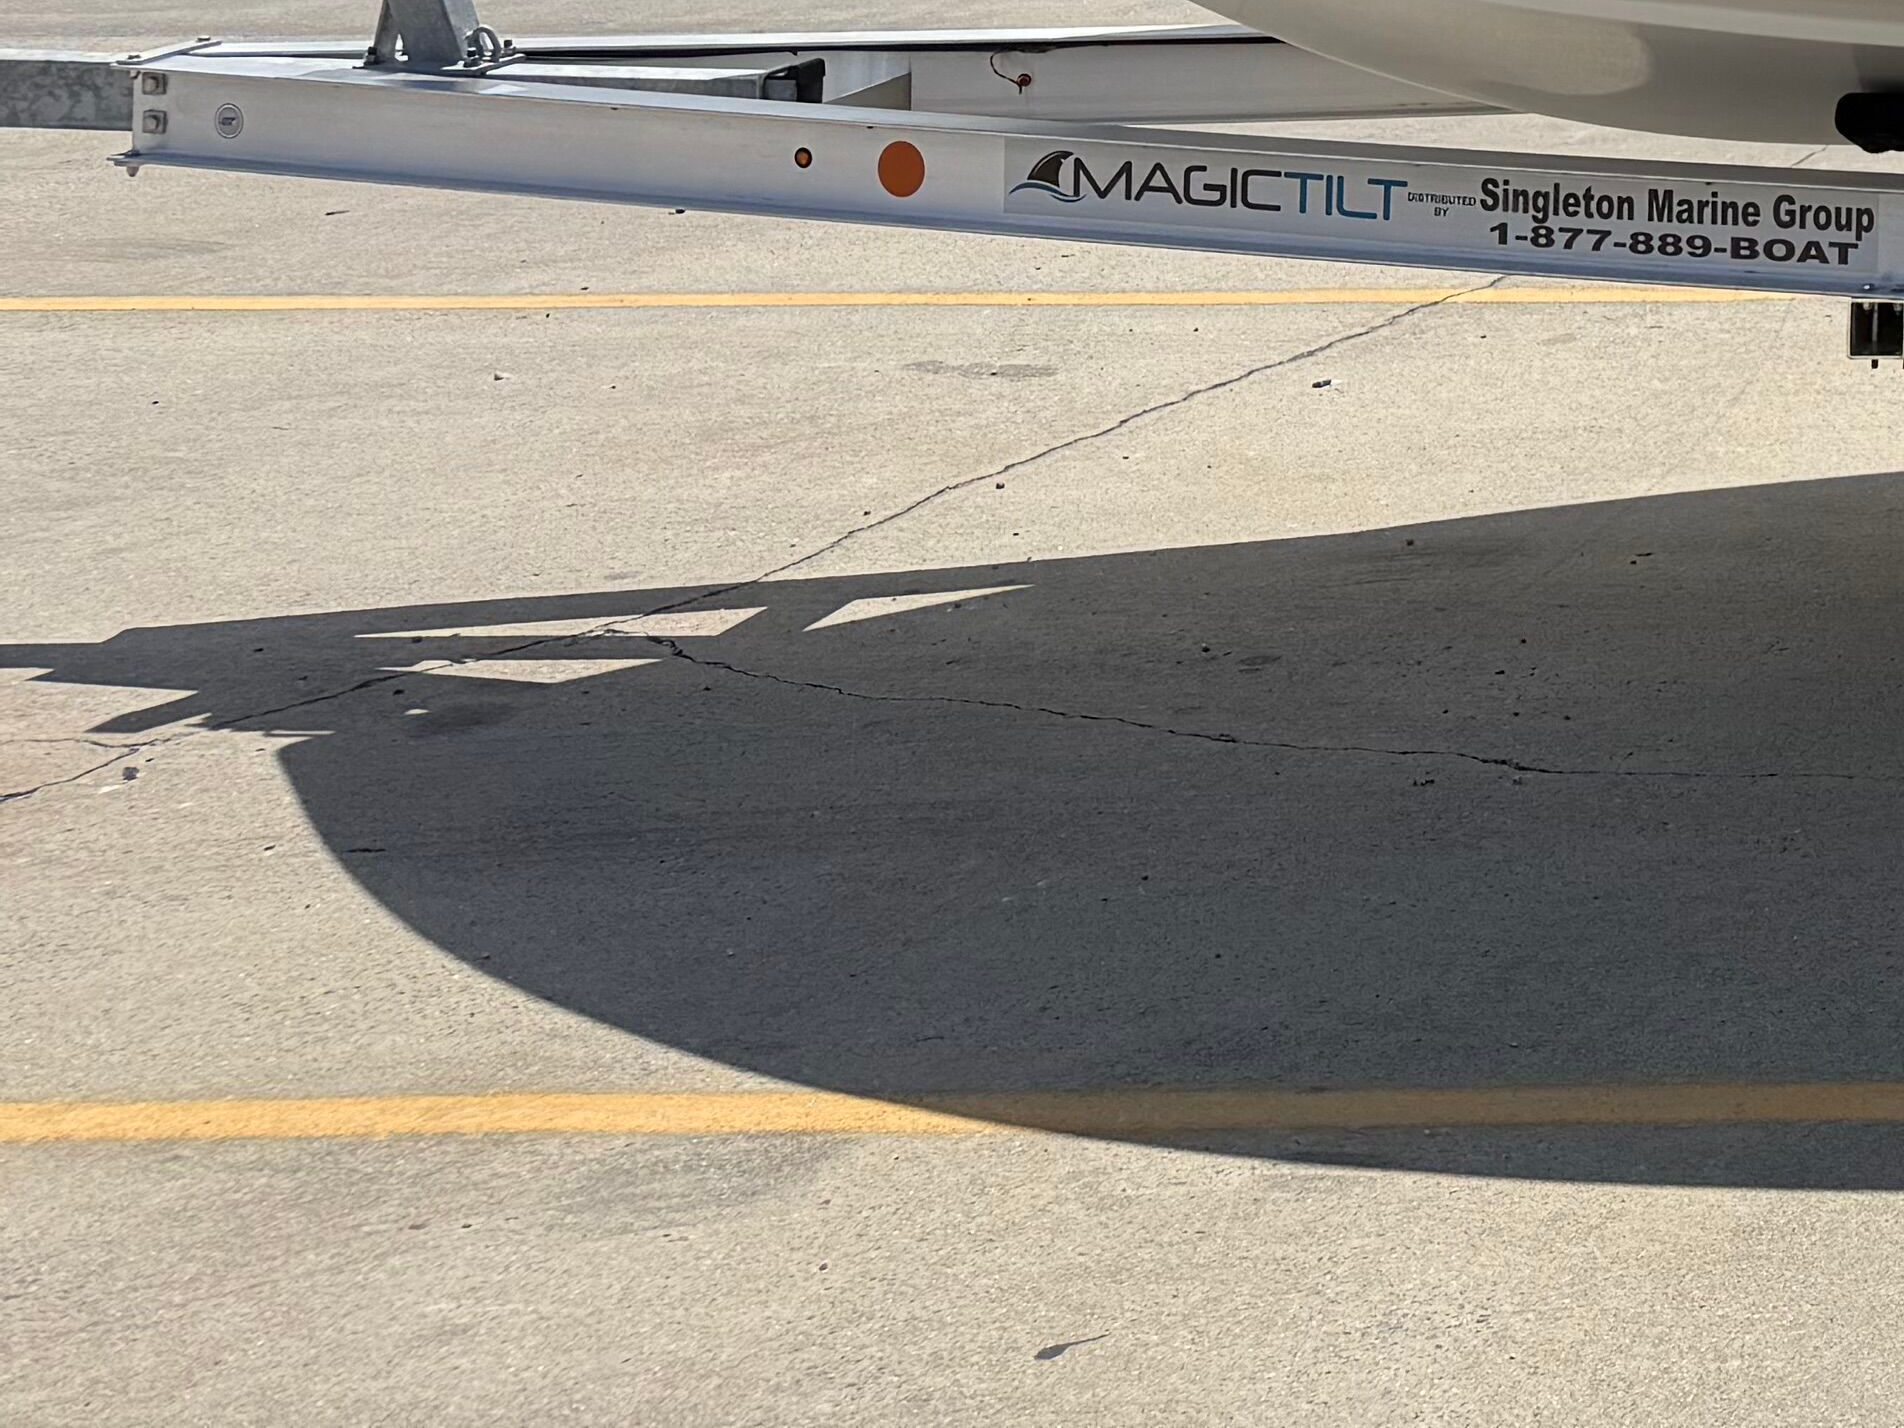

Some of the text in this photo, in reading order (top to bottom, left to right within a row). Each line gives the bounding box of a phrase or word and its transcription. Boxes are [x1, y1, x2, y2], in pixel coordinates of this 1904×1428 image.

[1073, 157, 1408, 221] MAGICTILT
[1434, 207, 1449, 217] BY
[1480, 177, 1875, 241] Singleton Marine Group
[1489, 222, 1858, 265] 1-877-889-BOAT
